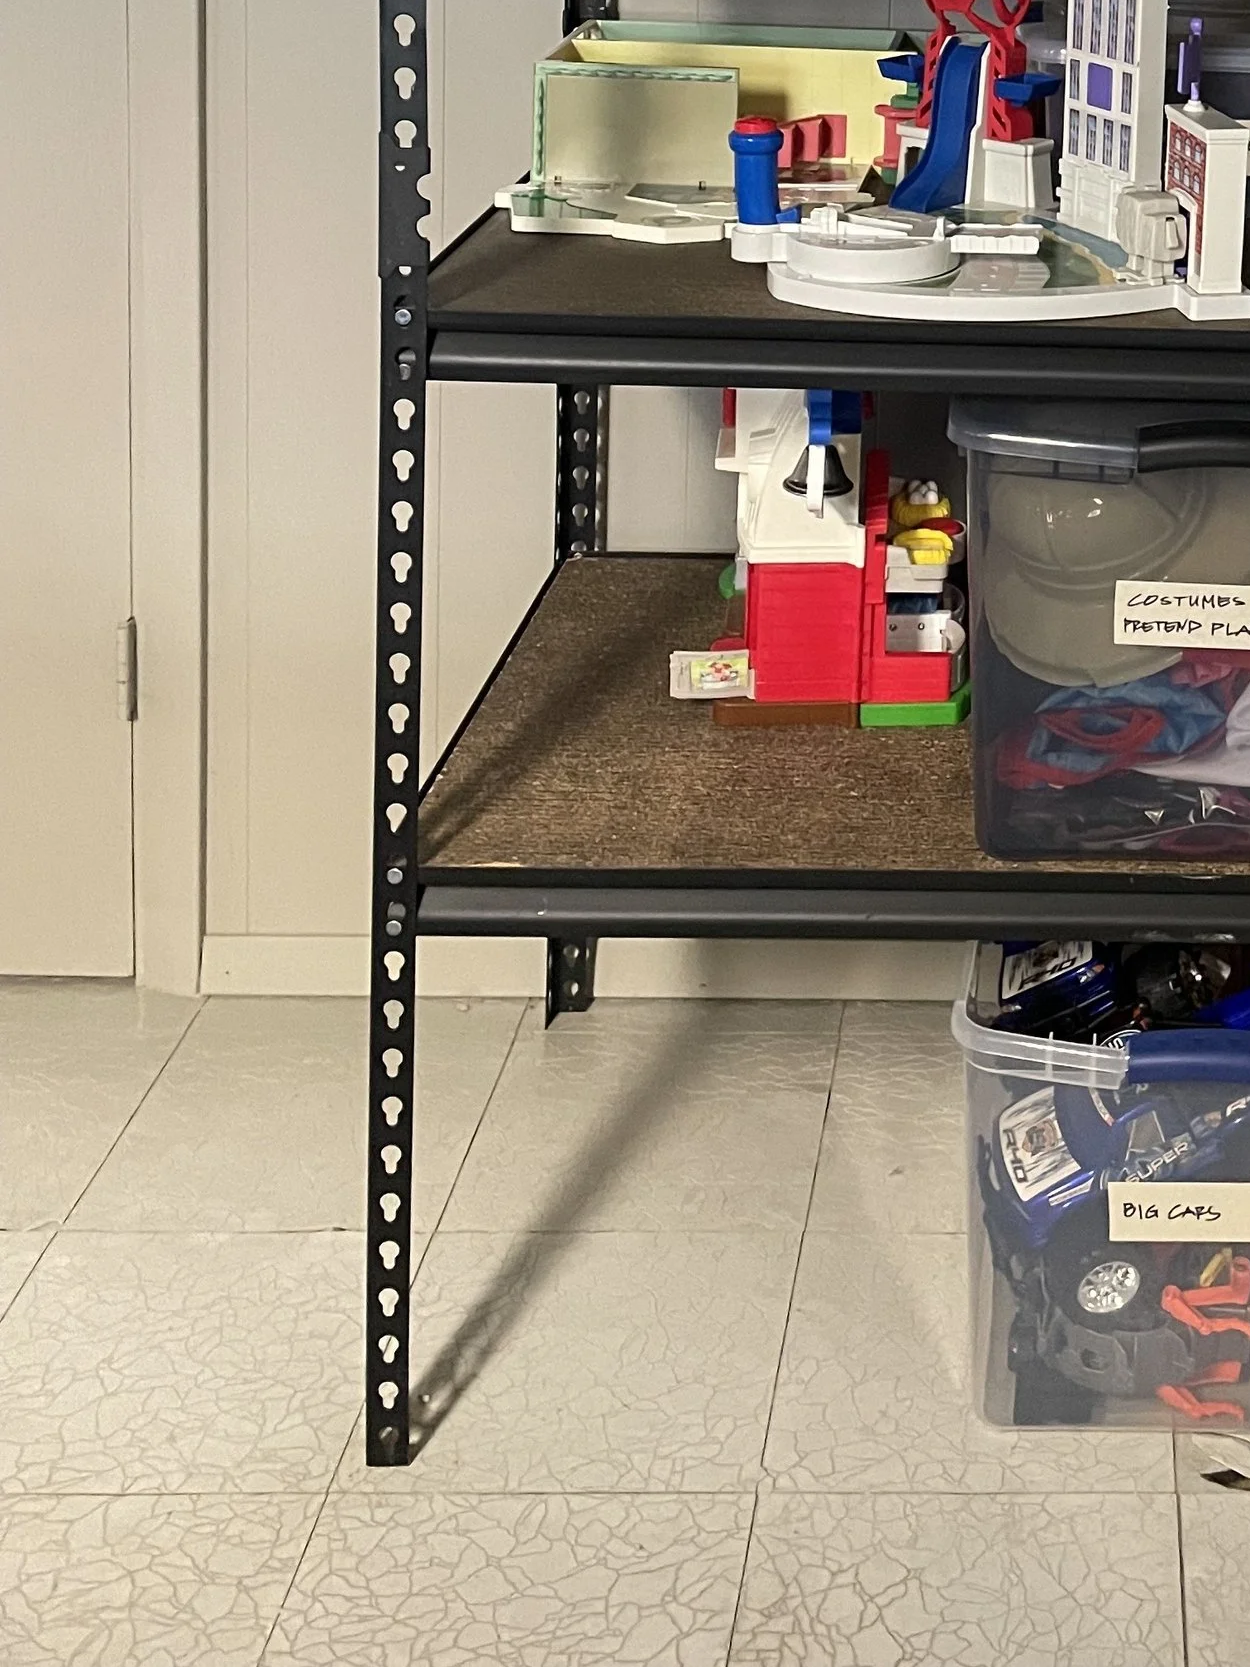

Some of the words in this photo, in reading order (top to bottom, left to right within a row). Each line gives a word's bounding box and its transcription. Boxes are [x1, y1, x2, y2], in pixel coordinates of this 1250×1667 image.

[1127, 593, 1246, 610] COSTUMES
[1123, 618, 1203, 634] PRETEND
[1125, 1141, 1190, 1183] SUPER
[1123, 1202, 1159, 1220] BIG
[1168, 1204, 1222, 1222] CARS
